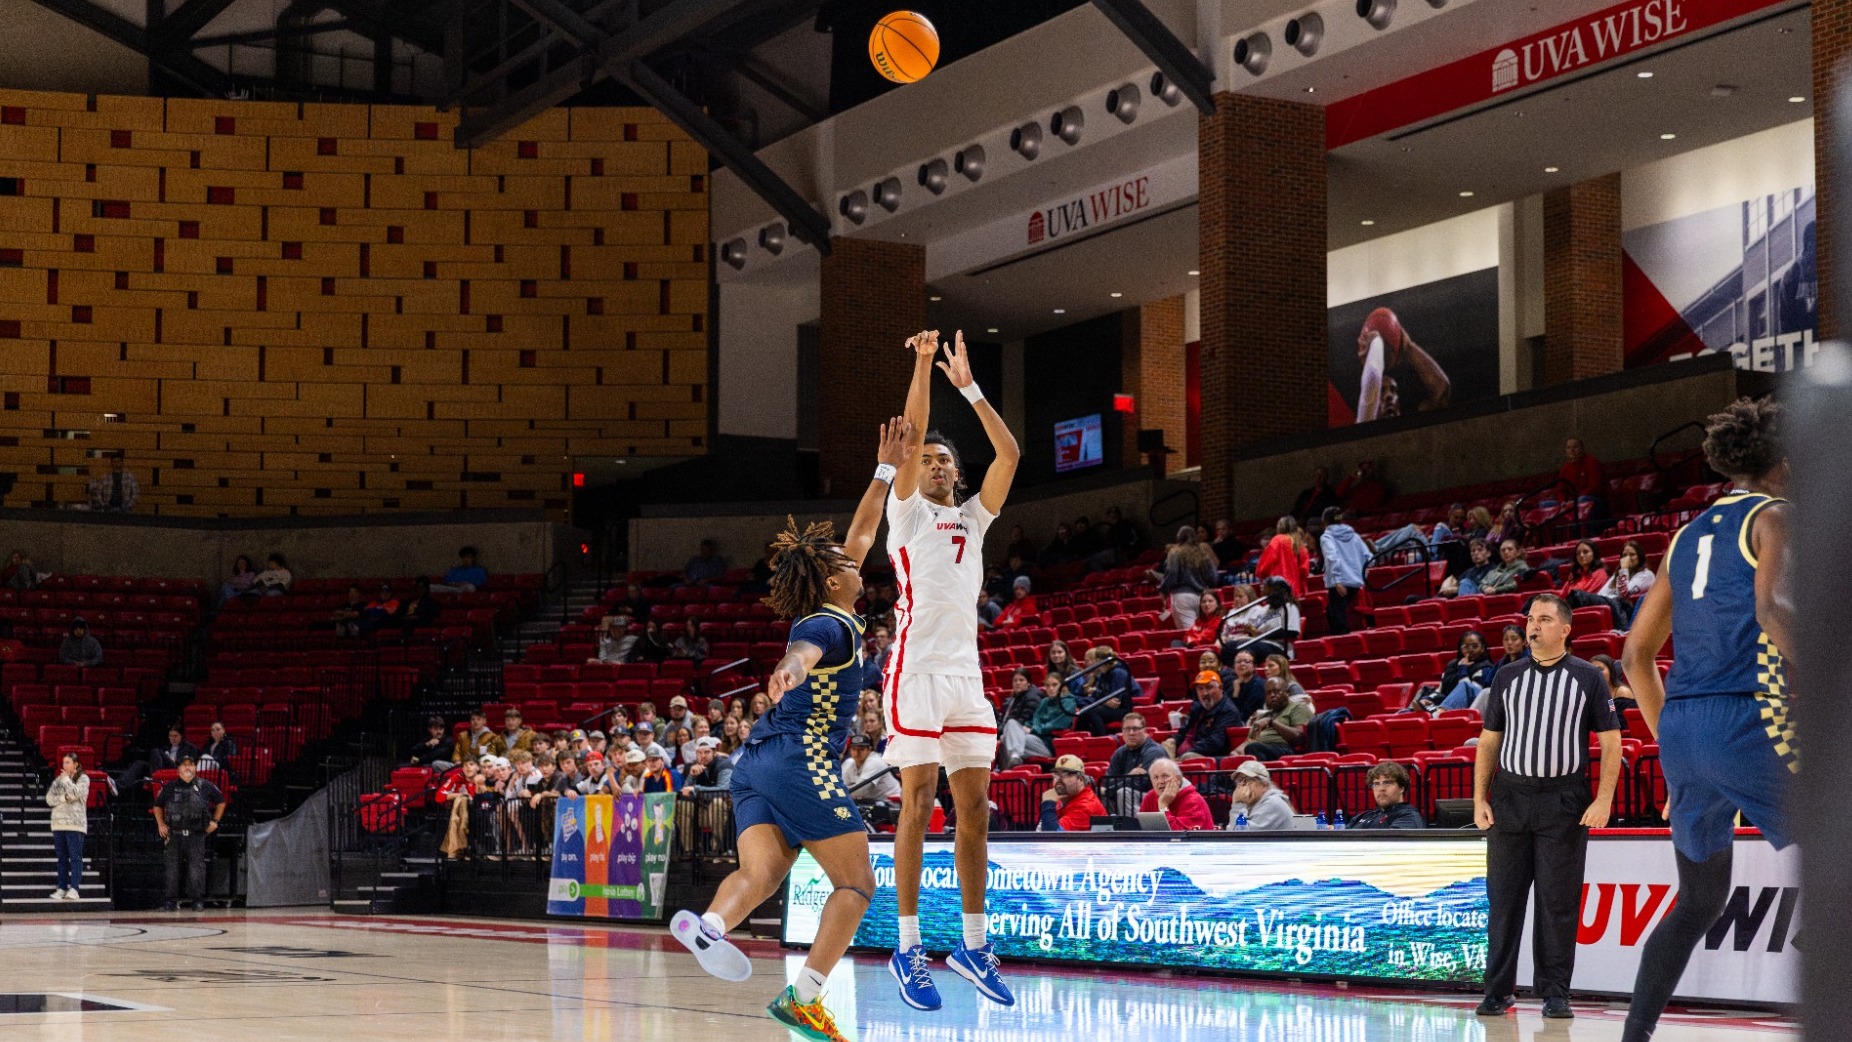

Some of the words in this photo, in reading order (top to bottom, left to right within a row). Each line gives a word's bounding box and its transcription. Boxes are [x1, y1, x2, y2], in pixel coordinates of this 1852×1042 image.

[1522, 27, 1589, 81] UVA
[1590, 0, 1687, 58] WISE
[1047, 199, 1088, 237] UVA
[1090, 176, 1150, 224] WISE
[952, 535, 967, 564] 7
[1692, 534, 1715, 600] 1
[918, 860, 958, 889] ocal
[984, 865, 1074, 892] ometown
[1081, 857, 1165, 906] Agency
[1058, 902, 1092, 939] All
[1098, 902, 1125, 941] of
[1125, 904, 1250, 948] Southwest
[1254, 908, 1367, 965] Virginia
[1382, 900, 1433, 926] Office
[1435, 902, 1488, 928] locate
[1575, 883, 1679, 947] UV
[1704, 885, 1800, 954] WI
[1387, 942, 1405, 965] in
[1409, 941, 1457, 976] Wise,
[1462, 943, 1487, 969] VA
